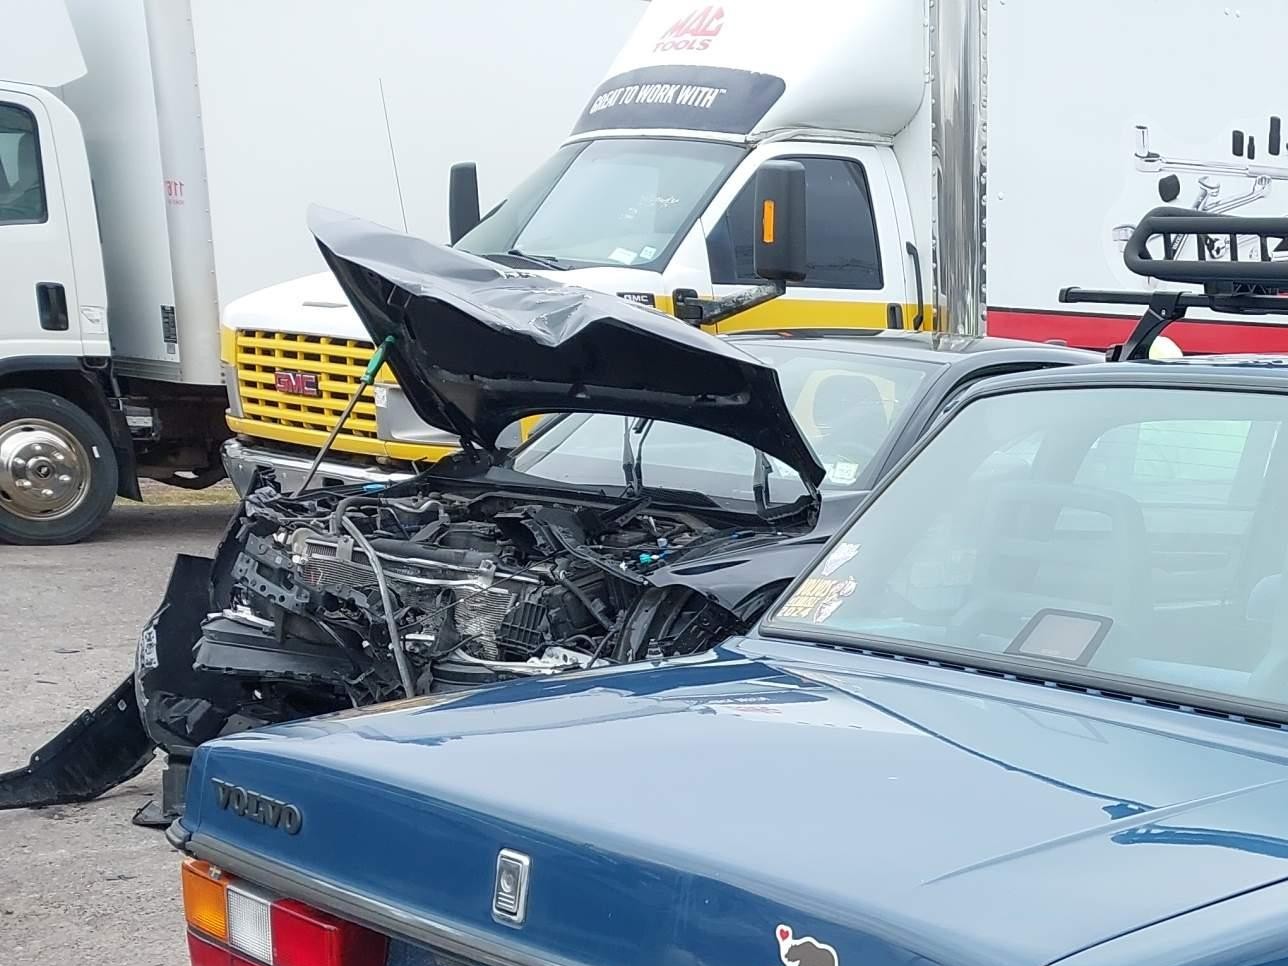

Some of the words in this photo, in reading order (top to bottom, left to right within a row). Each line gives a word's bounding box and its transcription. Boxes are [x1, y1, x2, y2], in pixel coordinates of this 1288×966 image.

[660, 5, 725, 39] MAC
[652, 38, 712, 53] TOOLS
[618, 85, 640, 105] TO
[635, 83, 680, 104] WORK
[275, 371, 318, 396] GMC
[210, 777, 303, 836] VOLVO
